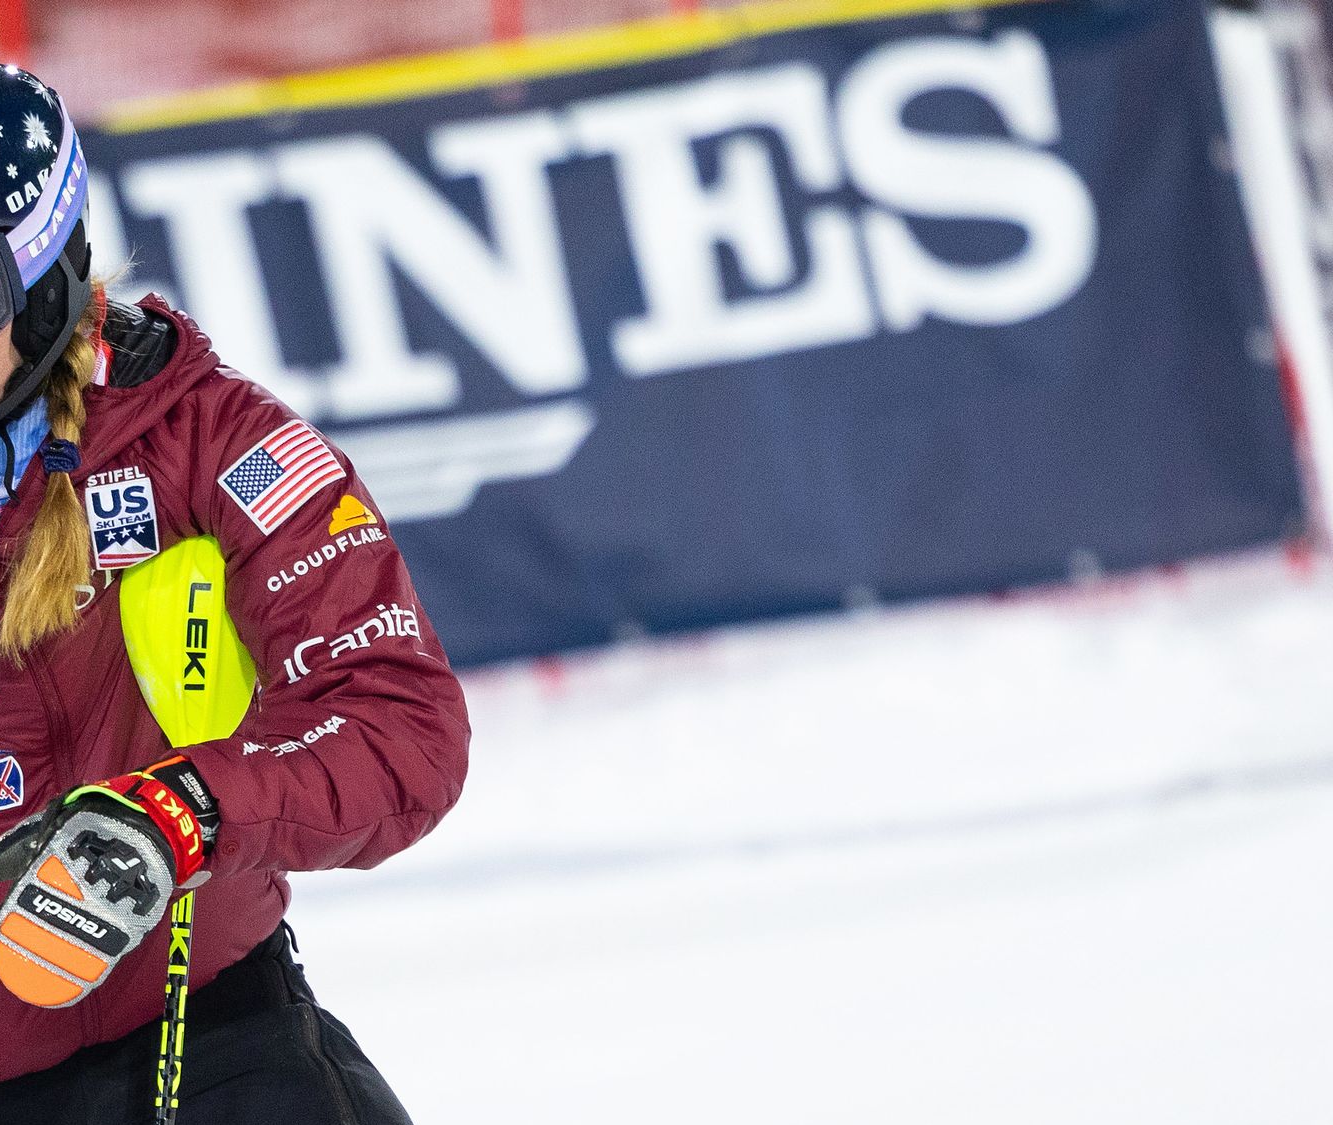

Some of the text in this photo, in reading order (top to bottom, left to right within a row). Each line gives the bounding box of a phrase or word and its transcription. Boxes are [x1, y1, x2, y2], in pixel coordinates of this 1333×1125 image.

[6, 162, 55, 213] OAK
[87, 466, 145, 487] STIFEL
[91, 486, 148, 519] US
[96, 512, 151, 529] SKI TEAM
[266, 528, 386, 592] CLOUDFLARE
[183, 582, 212, 691] LEKI
[155, 789, 199, 856] LEKI
[33, 894, 108, 939] reusch
